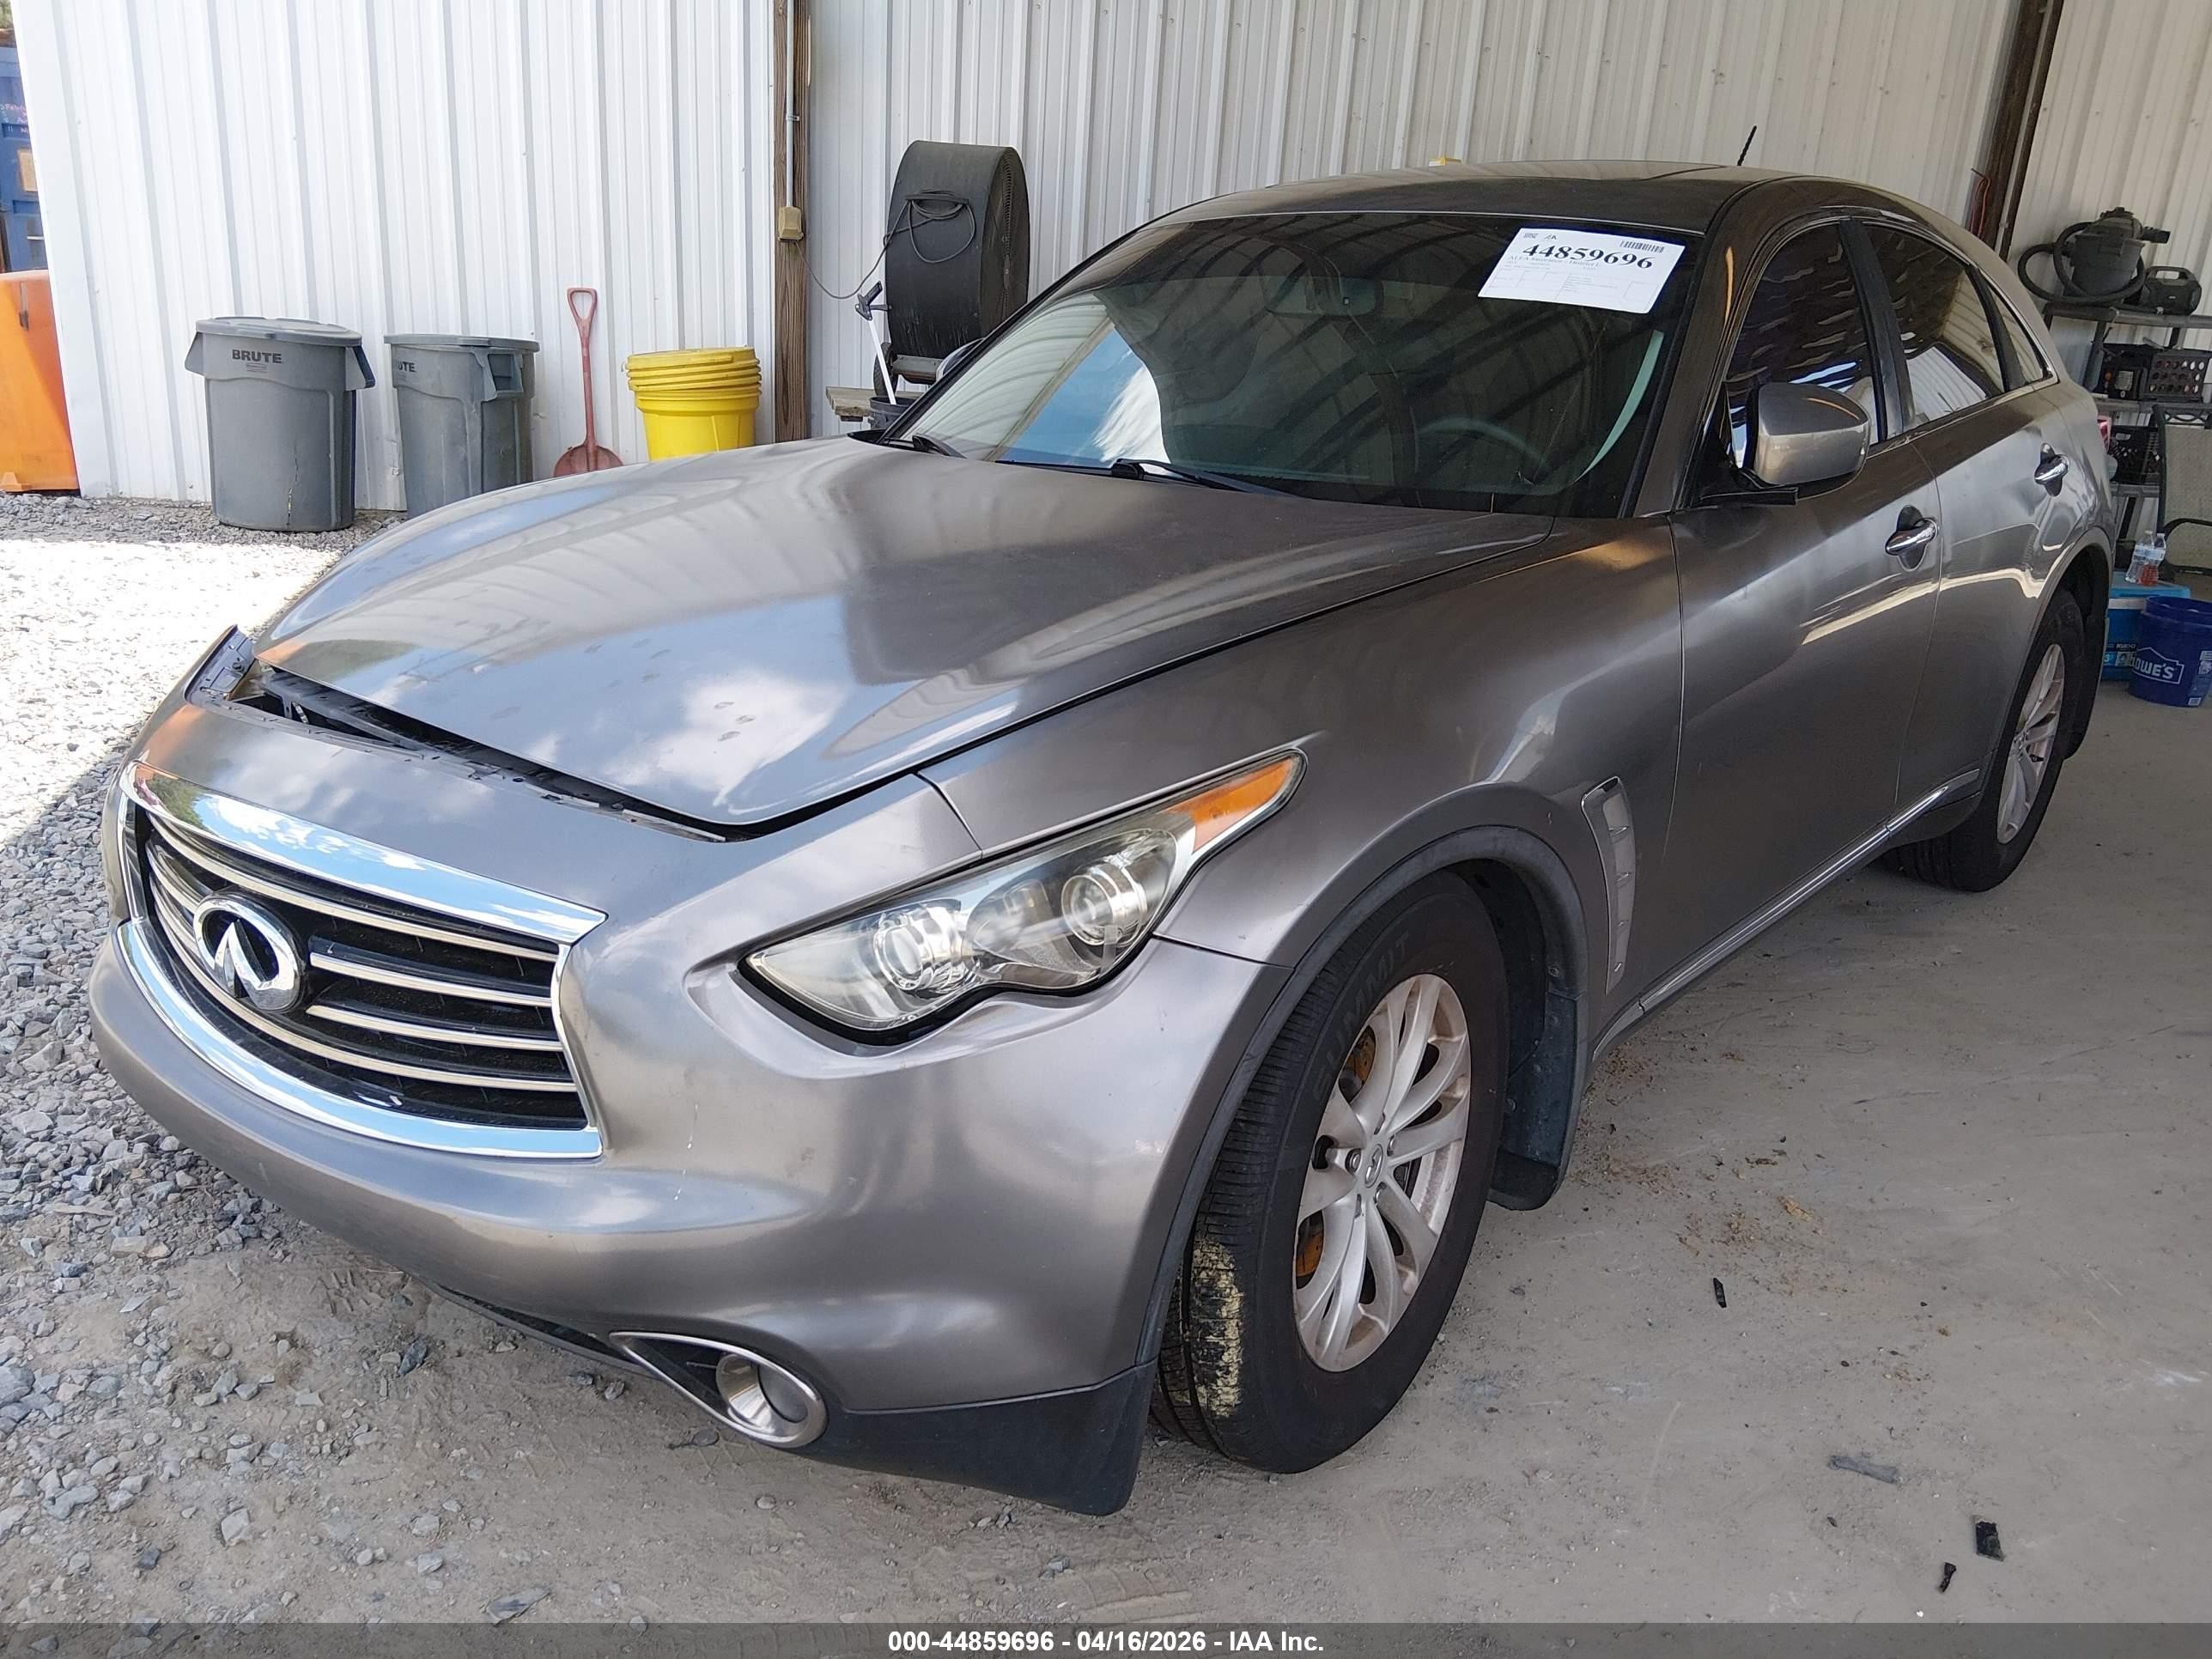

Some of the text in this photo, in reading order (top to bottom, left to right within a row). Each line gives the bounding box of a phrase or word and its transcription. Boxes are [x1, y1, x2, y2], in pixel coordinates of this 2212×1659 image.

[1522, 243, 1656, 270] 44859696
[232, 349, 283, 364] BRUTE
[398, 361, 417, 373] UTE
[1311, 930, 1410, 1103] SUMMIT
